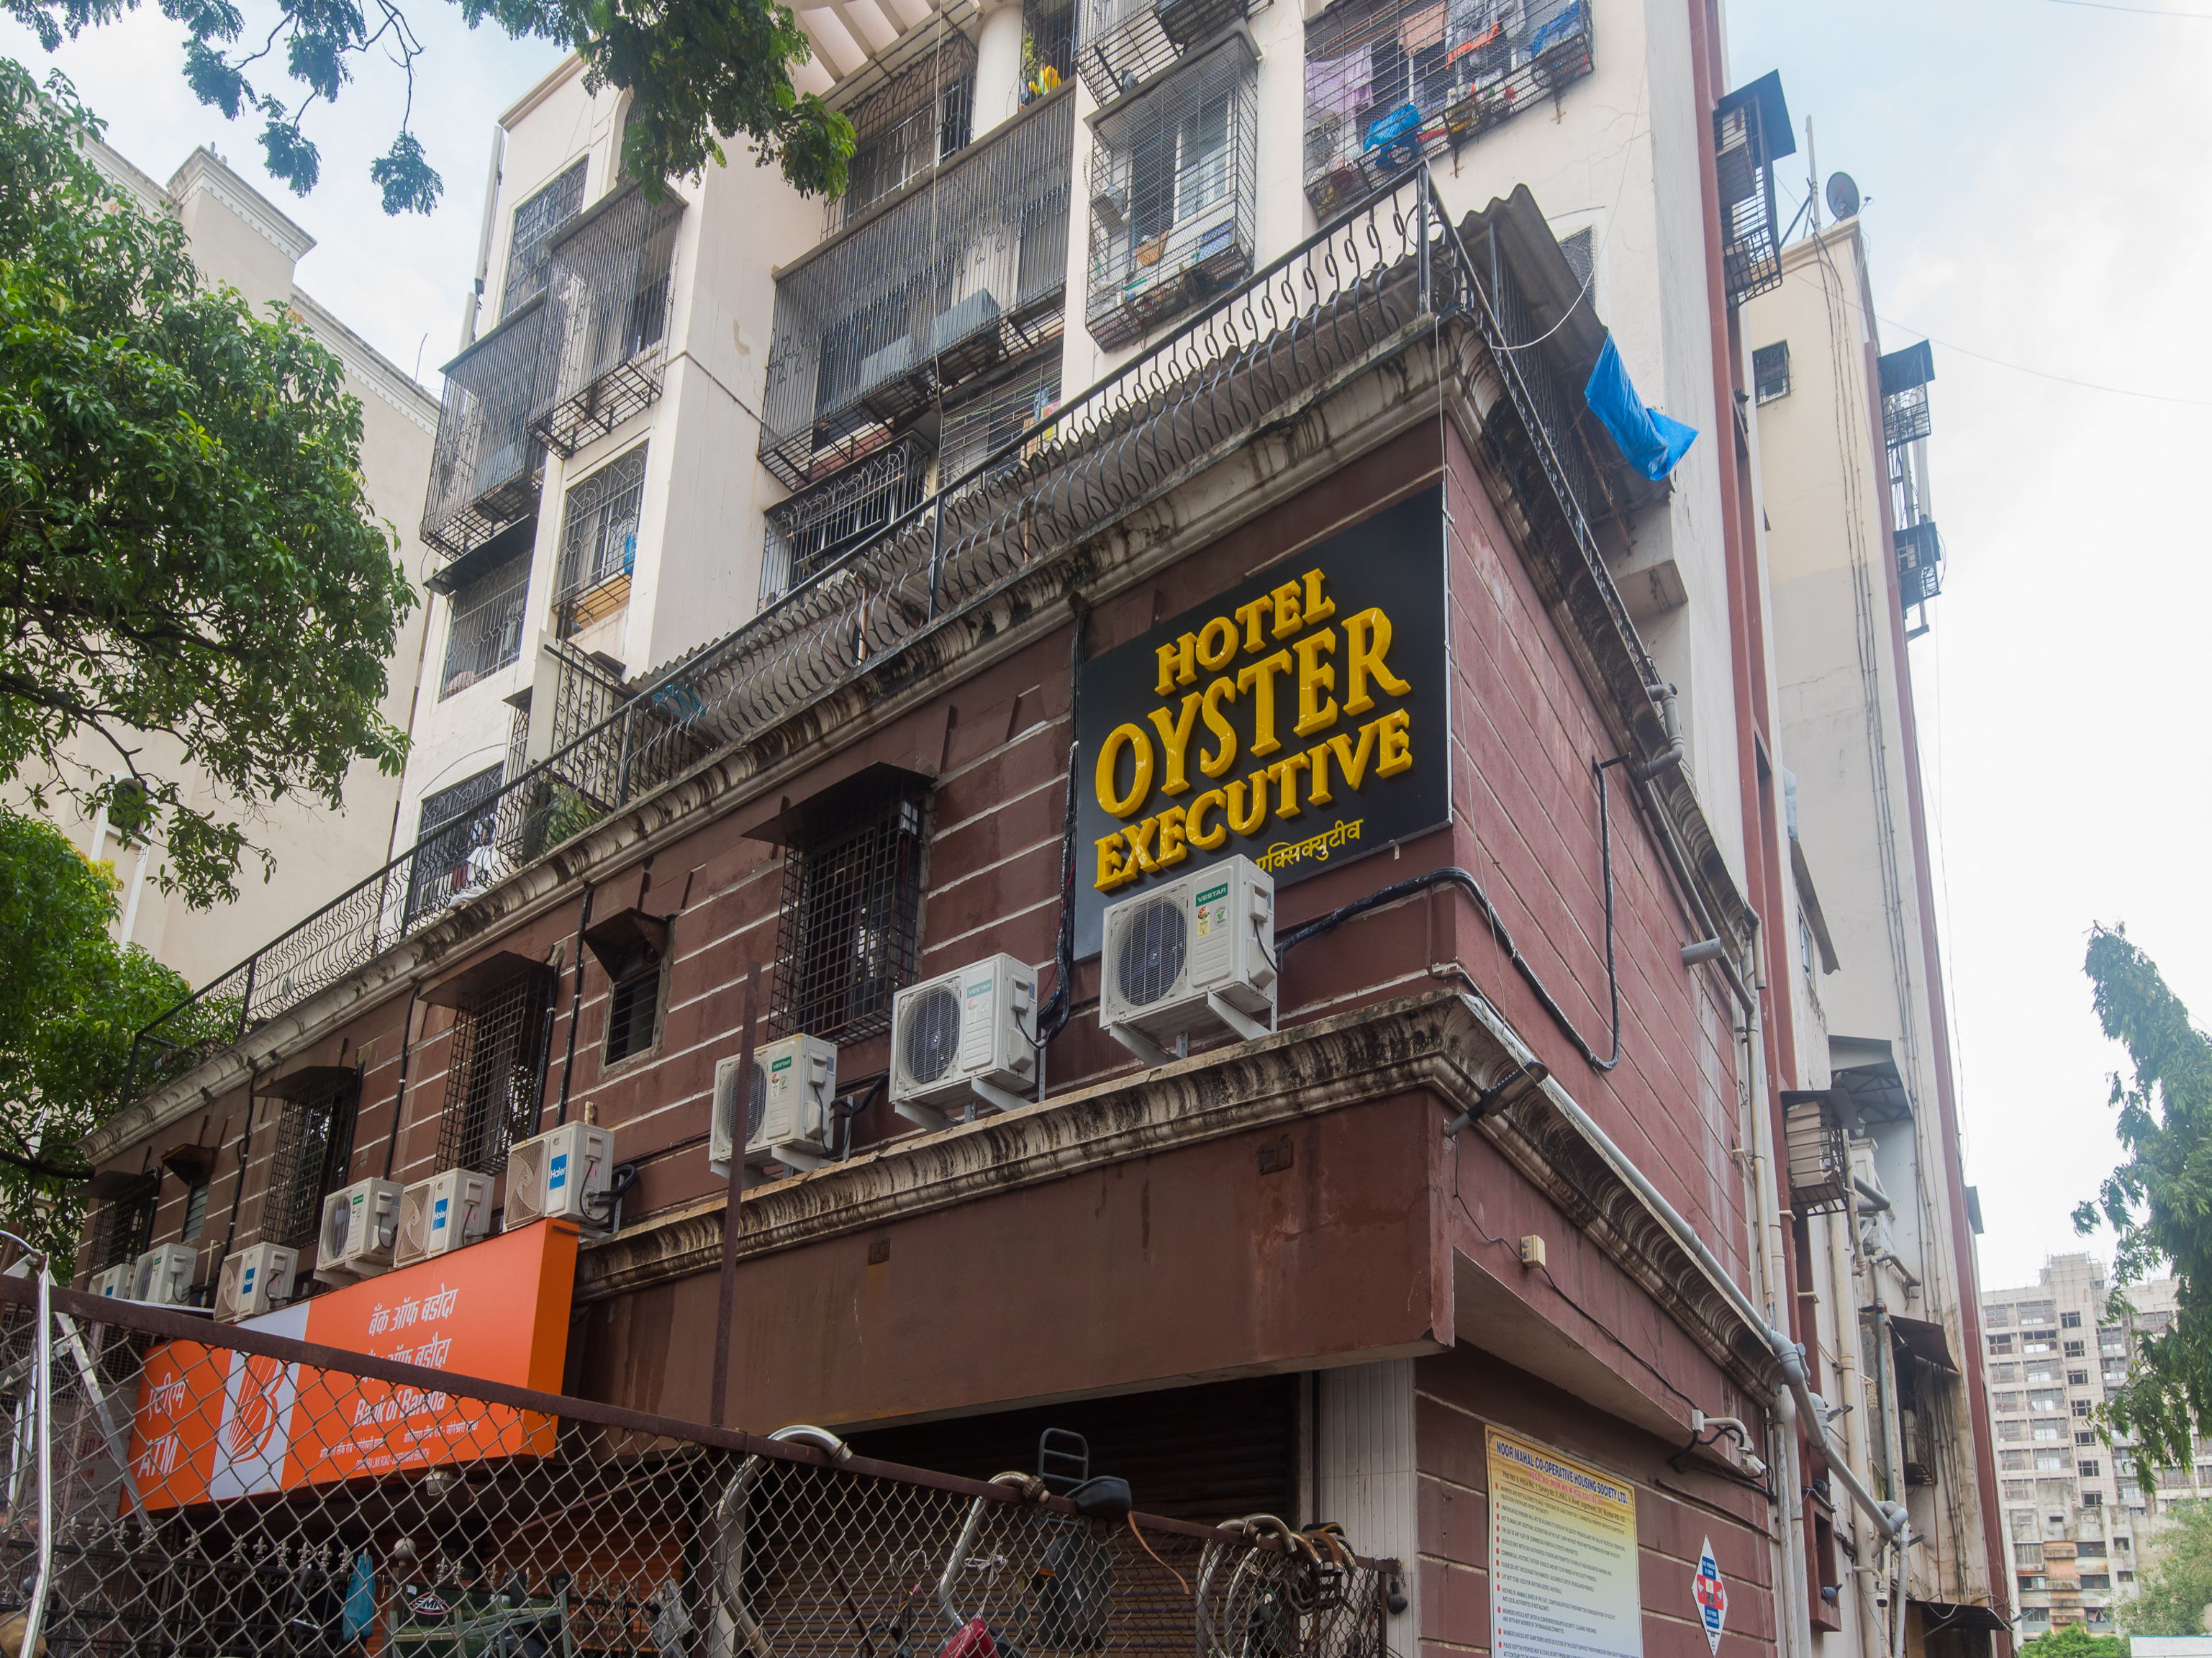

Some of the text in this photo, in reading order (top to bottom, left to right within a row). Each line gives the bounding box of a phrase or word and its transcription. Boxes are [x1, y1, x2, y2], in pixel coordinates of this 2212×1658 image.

[1154, 567, 1336, 697] HOTEL
[1094, 607, 1412, 819] OYSTER
[1093, 708, 1413, 892] EXECUTIVE
[1197, 887, 1227, 902] VESTAR
[968, 983, 991, 995] VESTAR
[773, 1059, 791, 1069] VESTAR
[550, 1167, 566, 1180] Haier
[433, 1210, 447, 1220] Haier
[389, 1296, 421, 1332] ऑफ
[148, 1372, 189, 1422] एटीएम
[353, 1388, 447, 1428] Bank of Baroda
[137, 1433, 180, 1479] ATM
[1496, 1440, 1514, 1459] NOOR
[1515, 1448, 1534, 1467] MAHAL
[1535, 1456, 1574, 1483] CO-OPERATIVE
[1574, 1472, 1597, 1492] HOUSING
[1597, 1482, 1617, 1501] SOCIETY
[1618, 1490, 1628, 1505] LTD.
